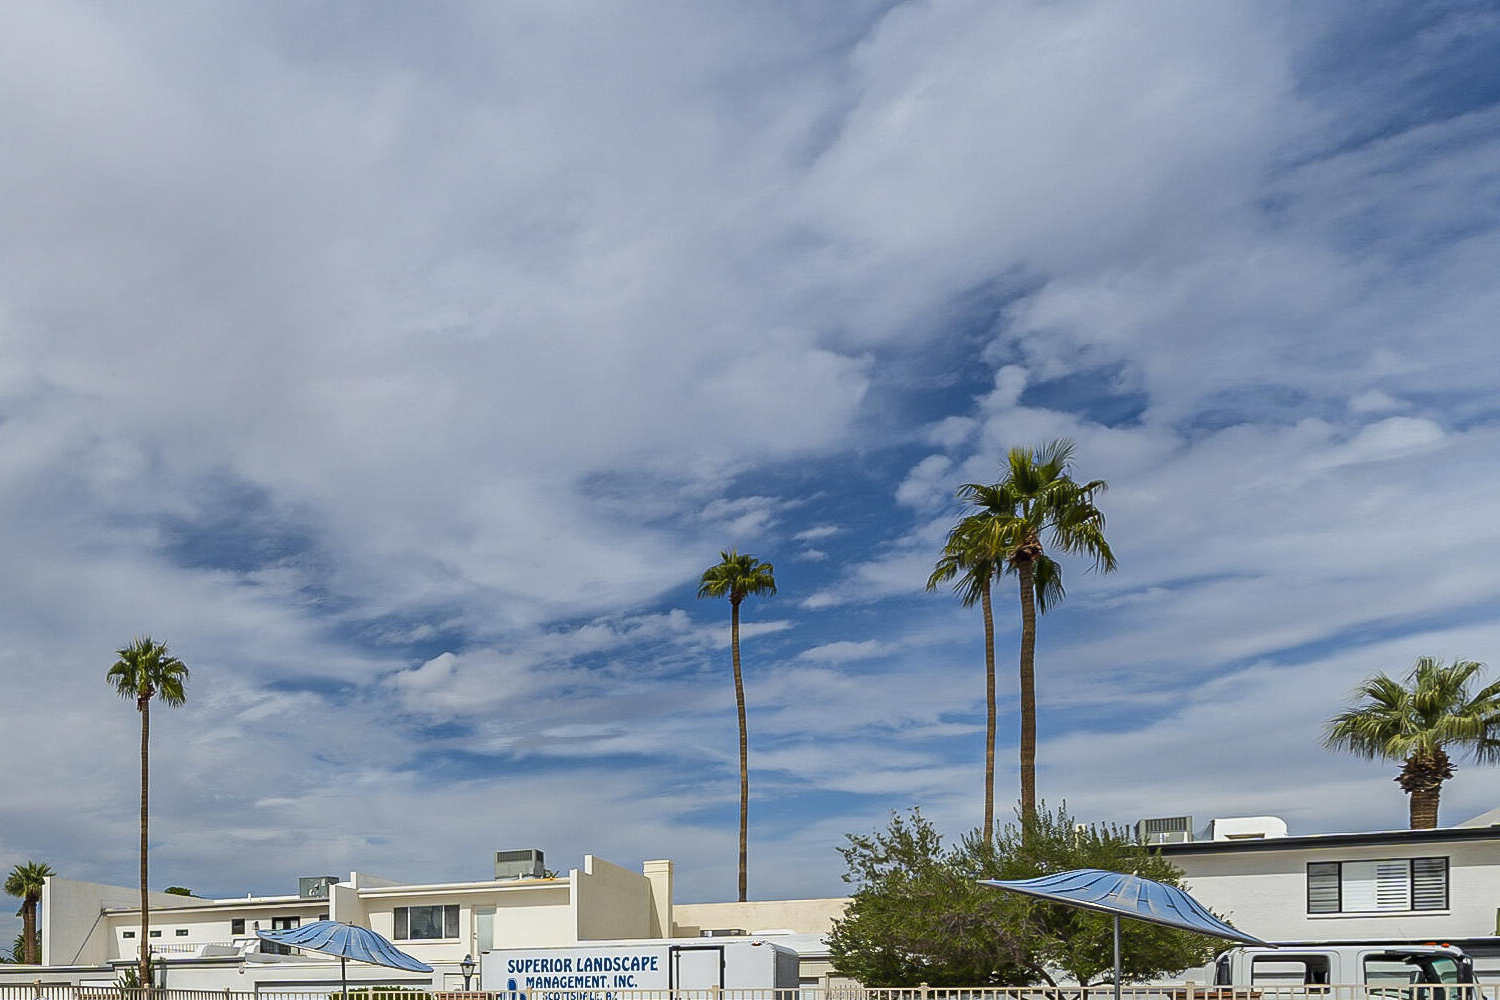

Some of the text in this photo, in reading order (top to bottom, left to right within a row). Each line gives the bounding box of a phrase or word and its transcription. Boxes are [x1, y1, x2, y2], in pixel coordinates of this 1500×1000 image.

[507, 956, 659, 974] SUPERIOR LANDSCAPE
[613, 975, 638, 989] INC.
